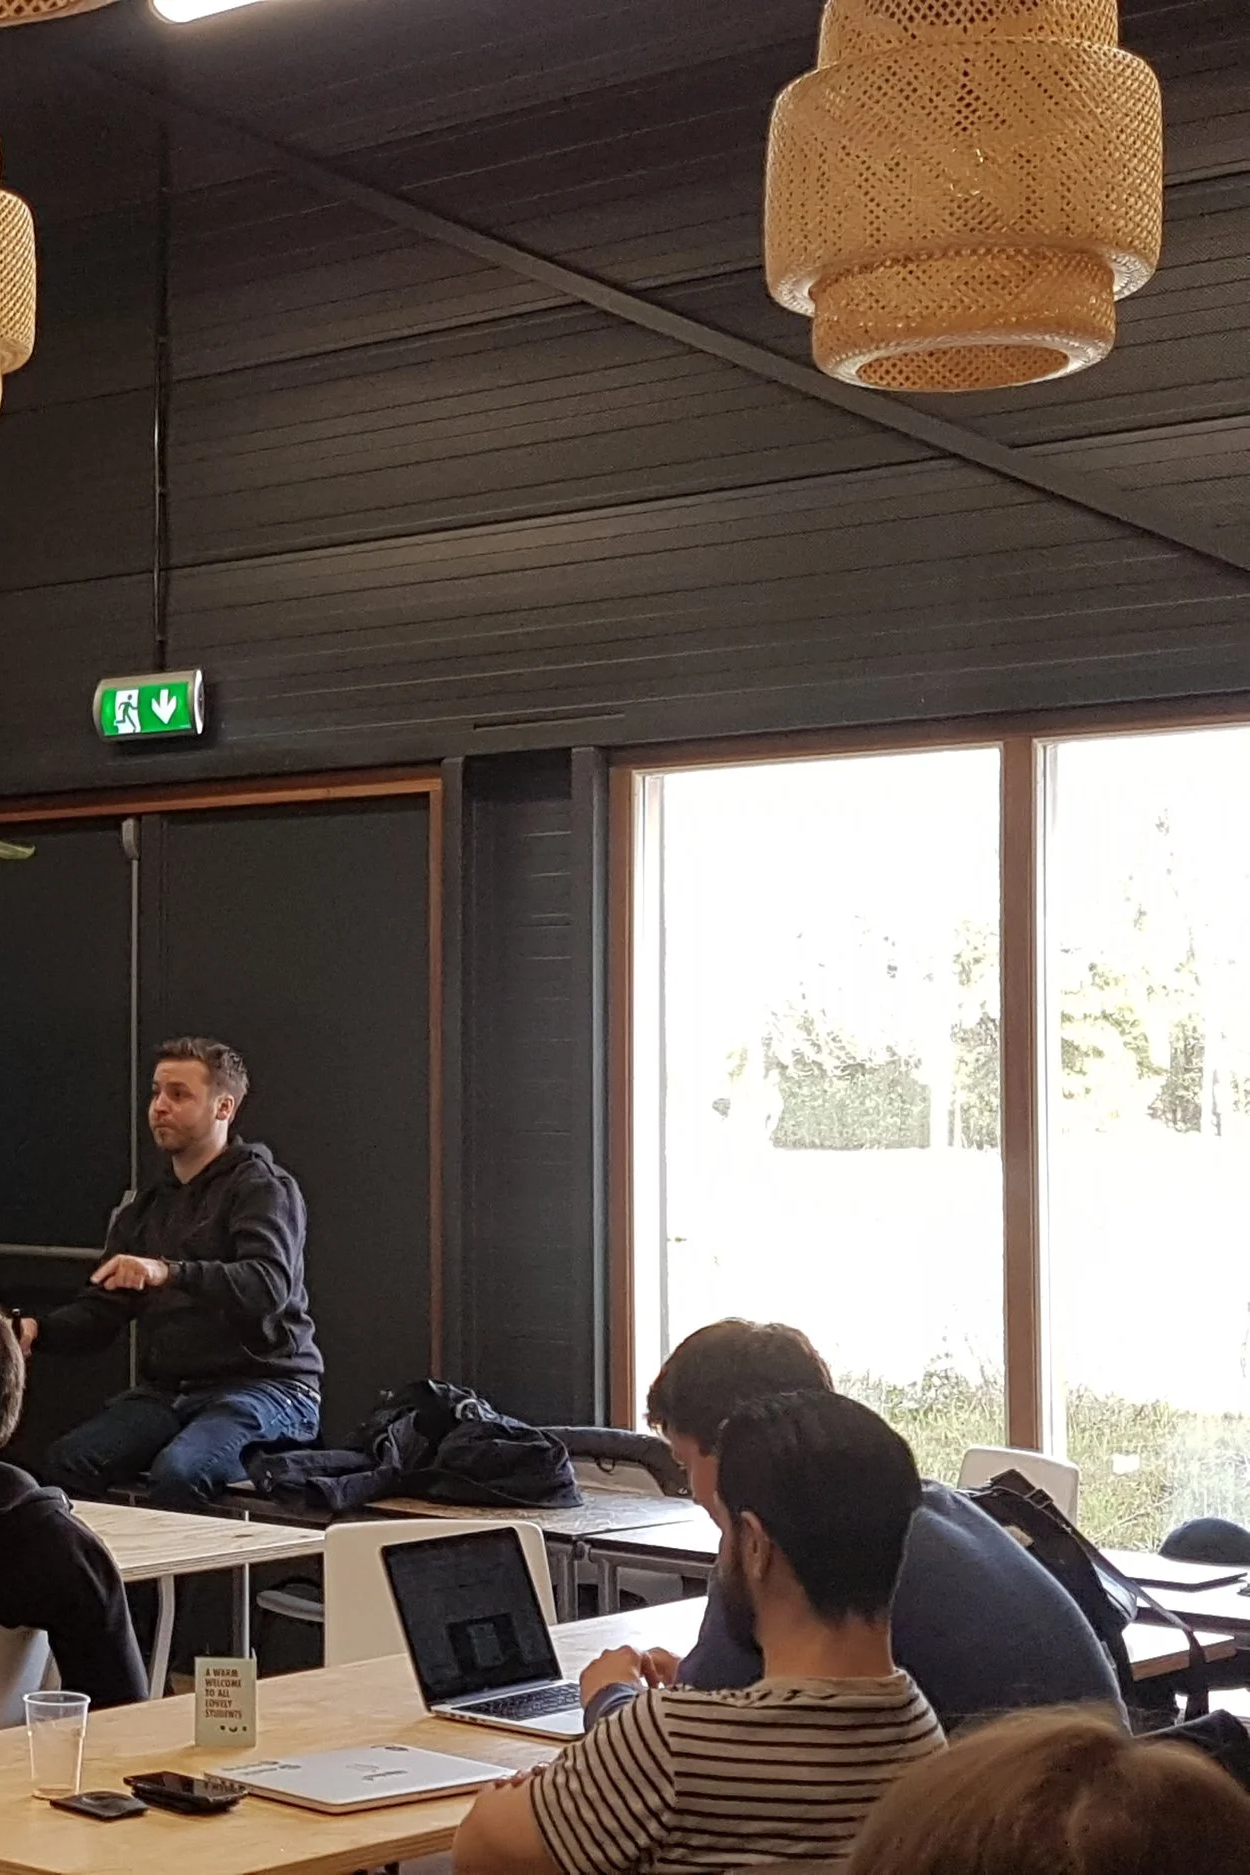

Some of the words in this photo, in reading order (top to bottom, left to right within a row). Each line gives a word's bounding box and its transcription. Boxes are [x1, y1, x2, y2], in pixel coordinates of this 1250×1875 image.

[206, 1668, 211, 1677] A
[213, 1668, 239, 1677] WARM
[205, 1679, 242, 1688] WELCOME
[205, 1689, 215, 1697] TO
[218, 1689, 230, 1698] ALL
[205, 1699, 233, 1708] LOVELY
